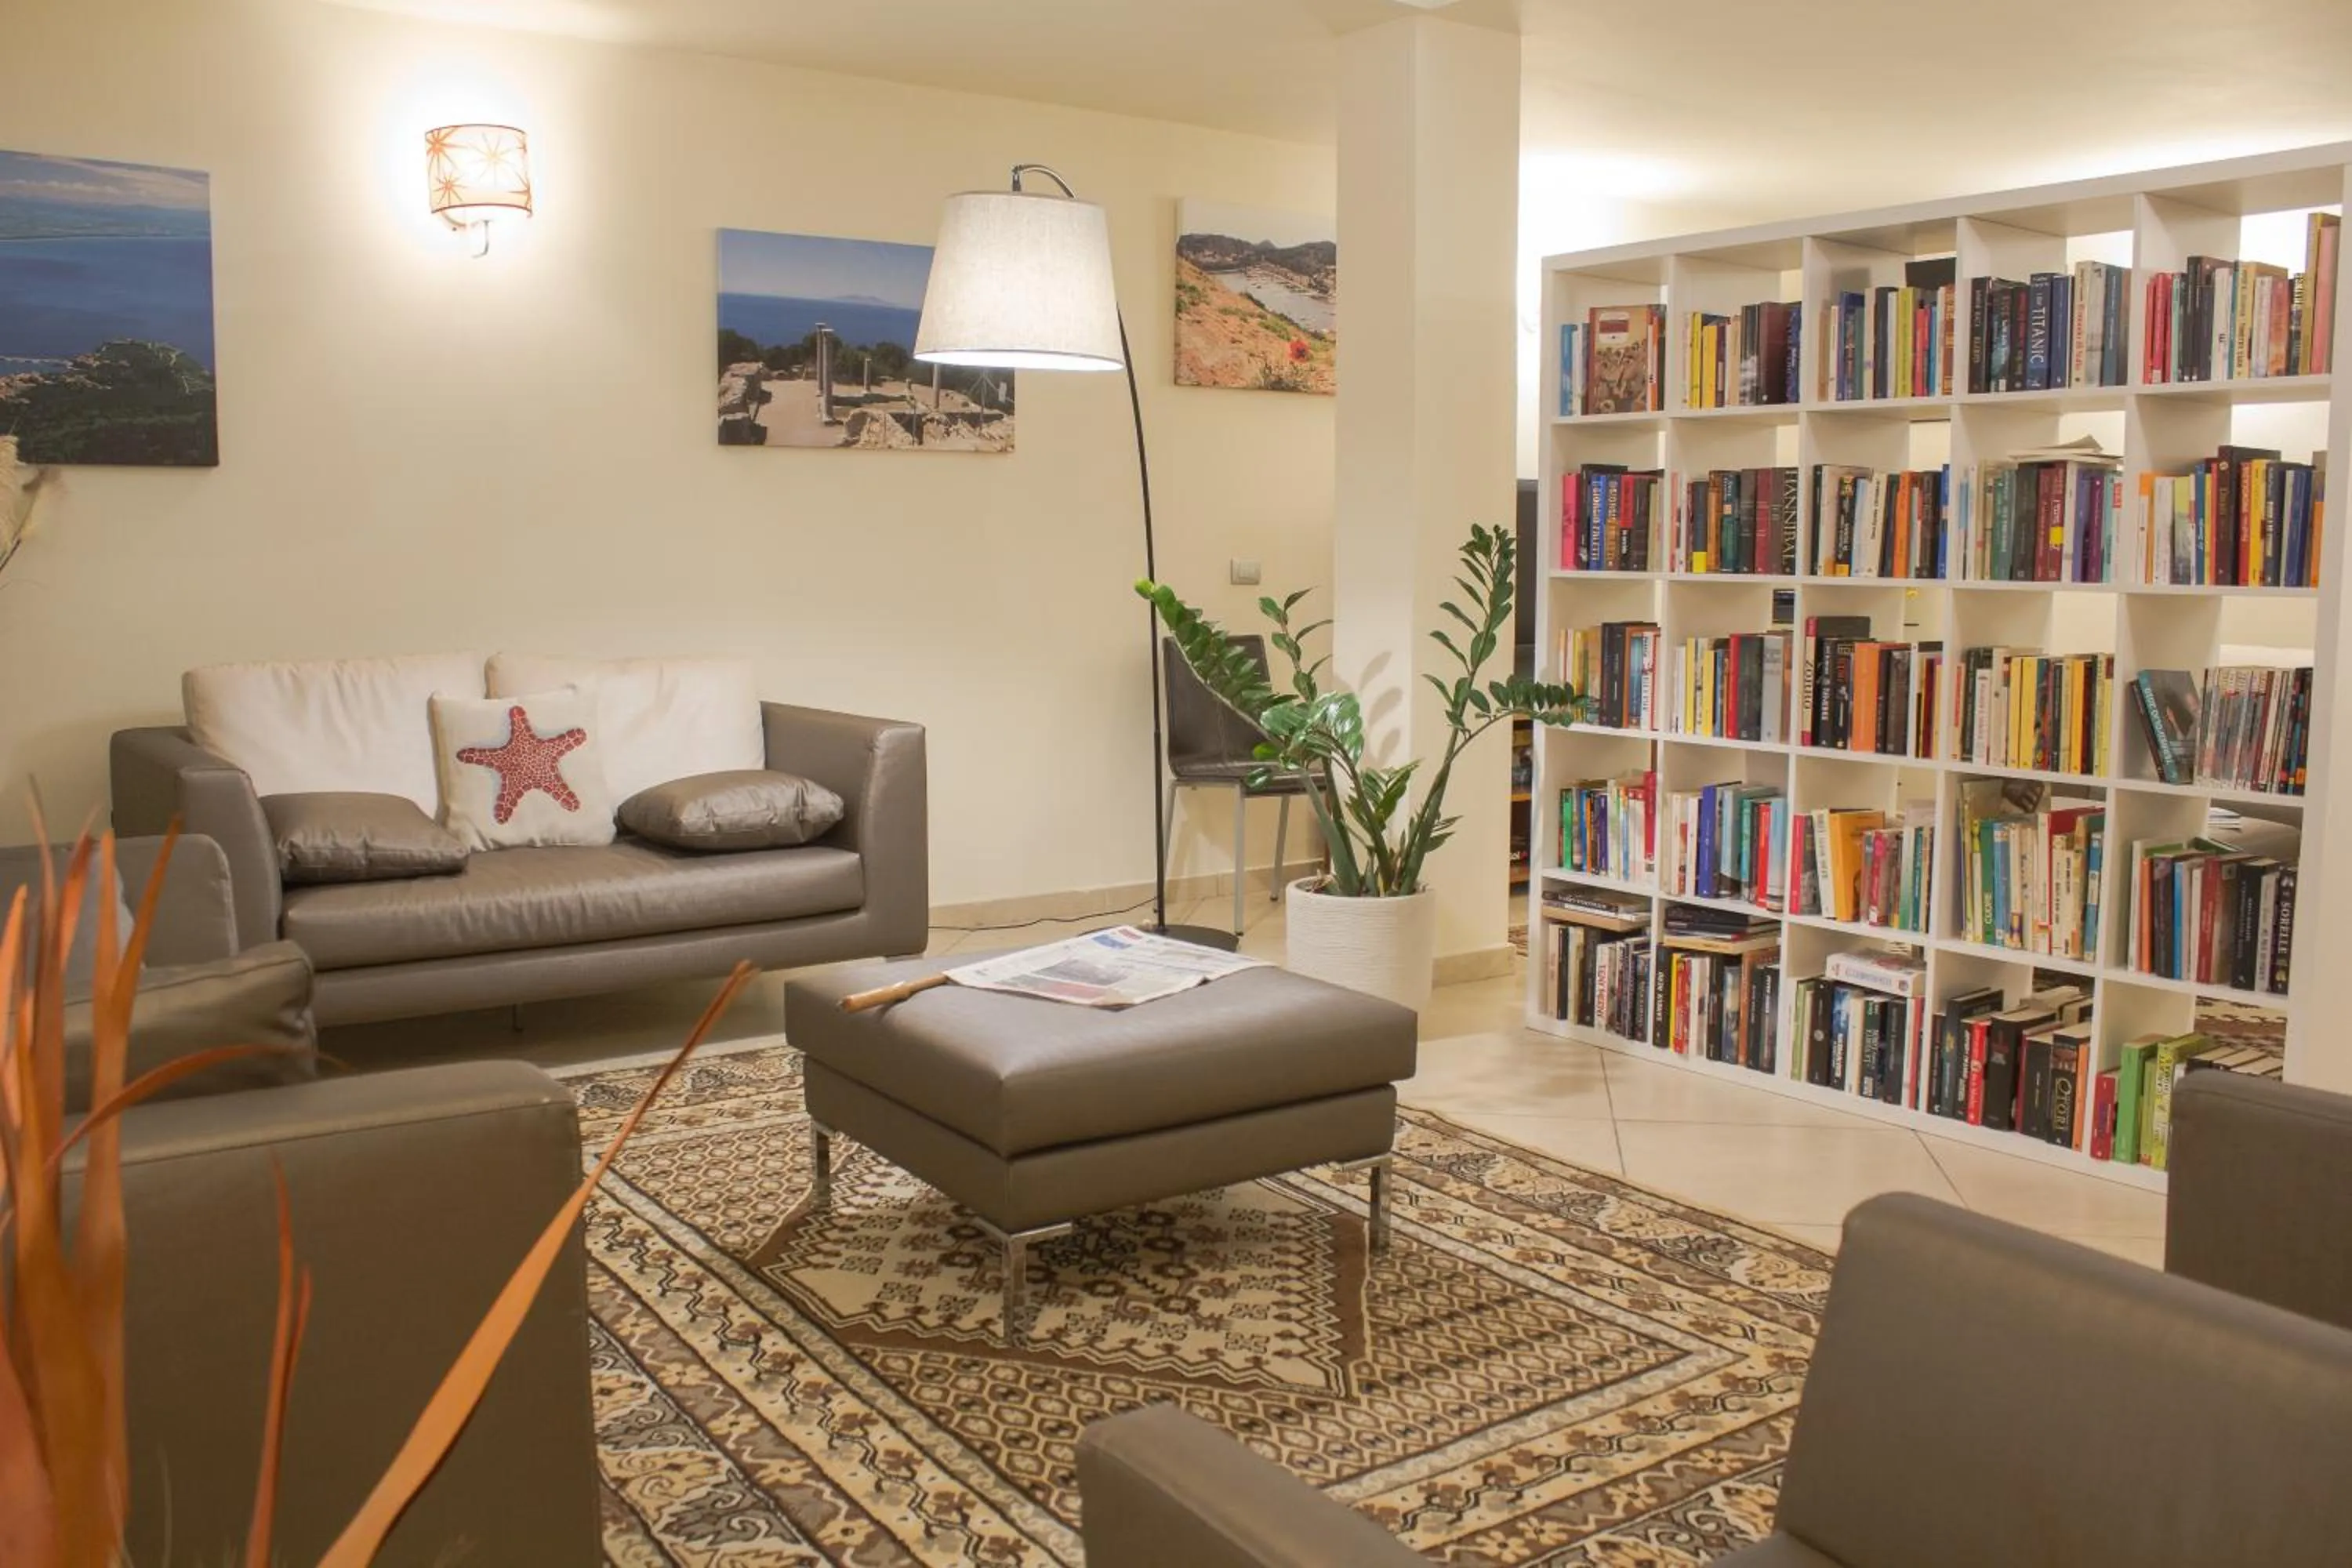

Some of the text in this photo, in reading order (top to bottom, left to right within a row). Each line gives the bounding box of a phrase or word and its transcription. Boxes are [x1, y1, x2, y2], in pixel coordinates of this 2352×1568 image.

[2031, 307, 2046, 365] TITANIC
[1591, 526, 1601, 561] FALETTI
[1782, 470, 1798, 564] HANNIBAL
[2278, 901, 2291, 954] SORELLE
